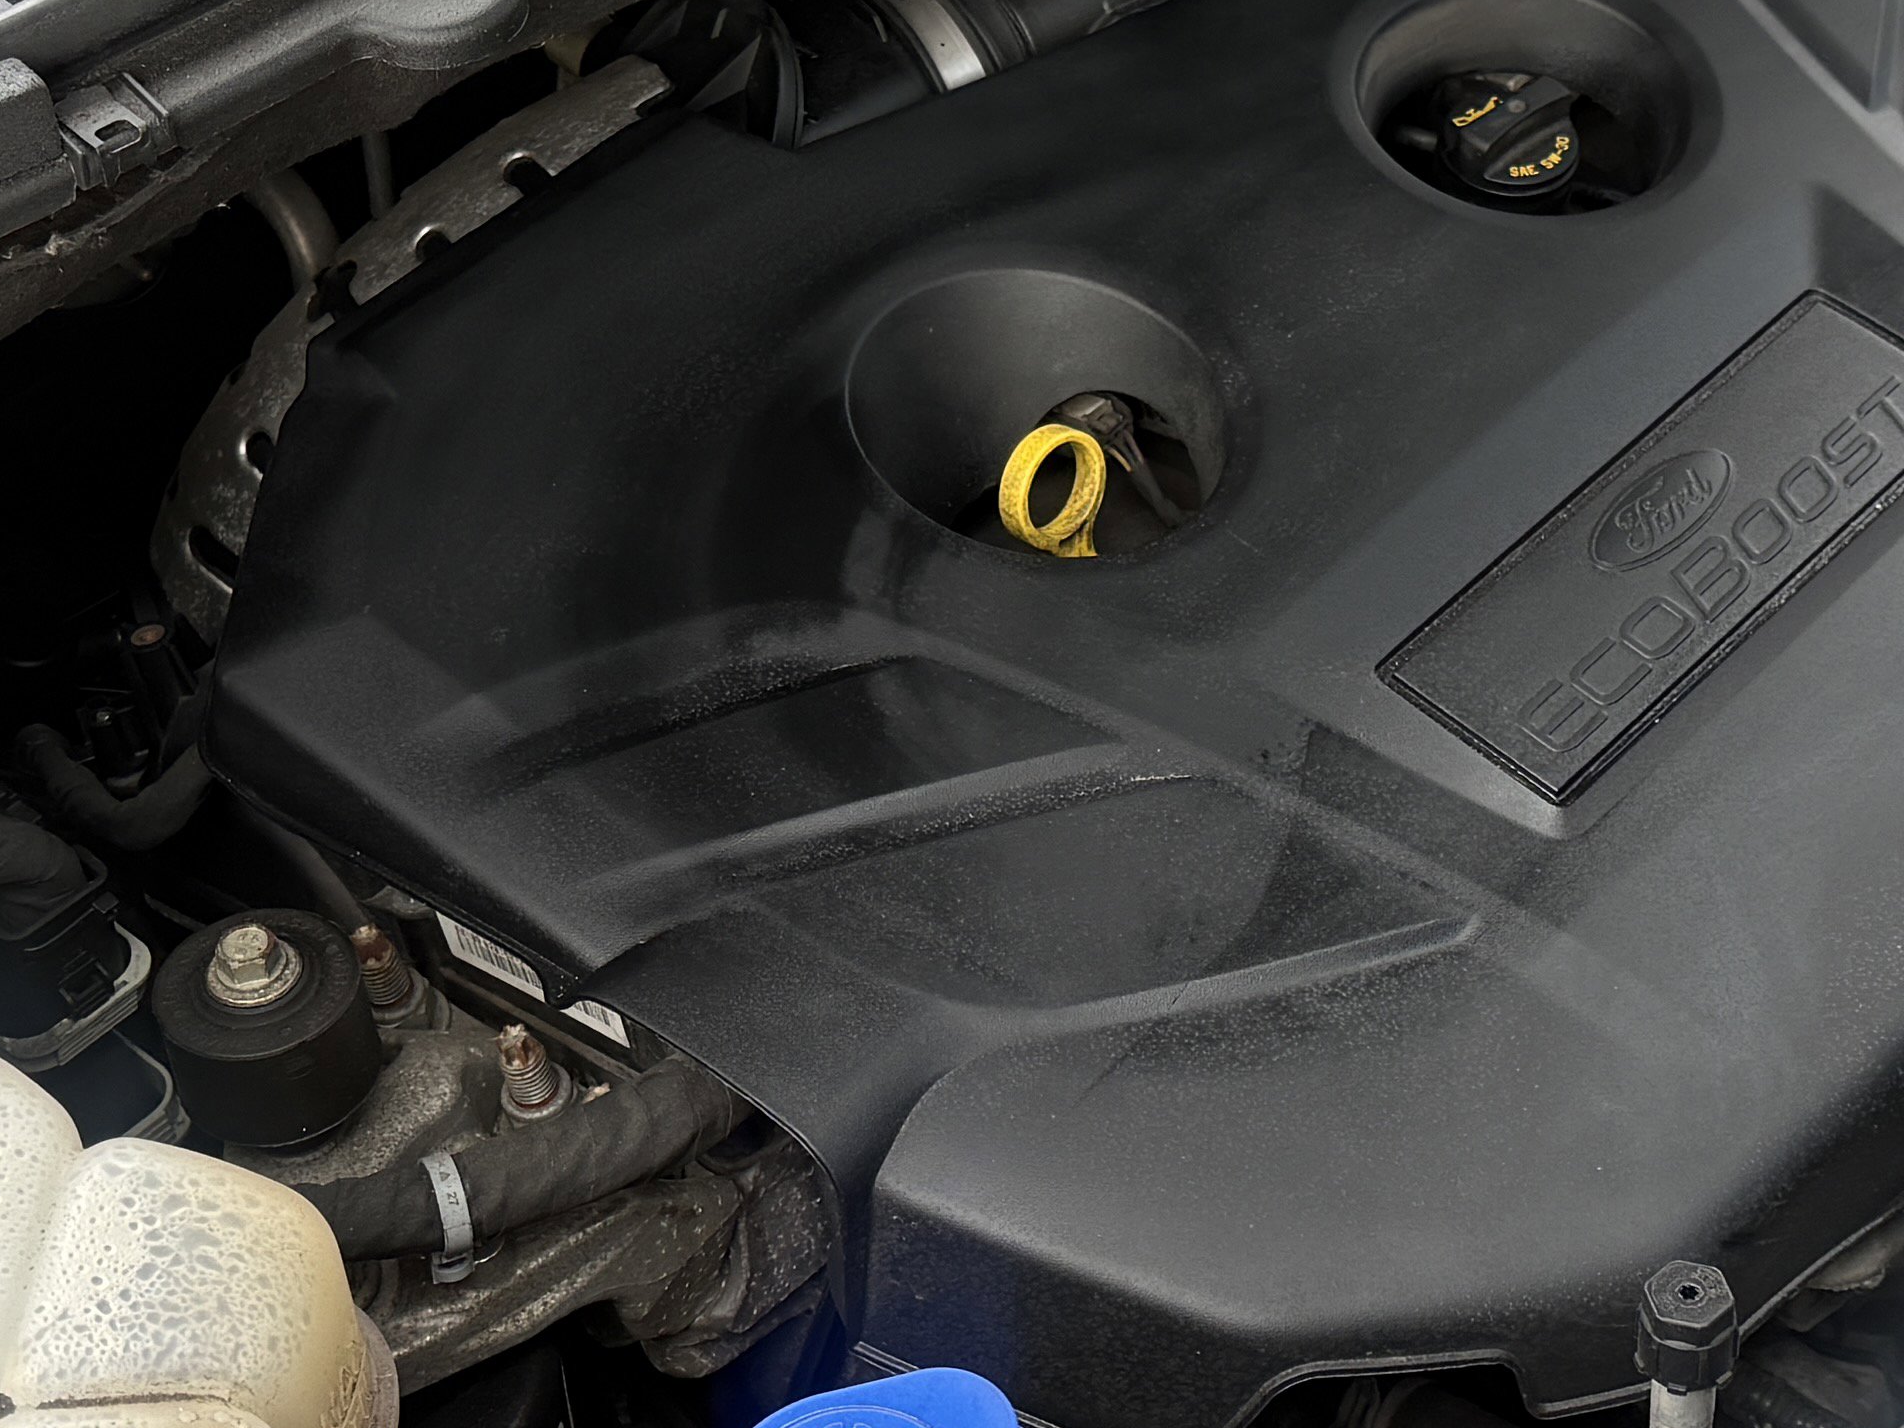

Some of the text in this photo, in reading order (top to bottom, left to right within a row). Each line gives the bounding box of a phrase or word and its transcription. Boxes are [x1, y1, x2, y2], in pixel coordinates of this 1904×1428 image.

[1509, 136, 1571, 178] SAE 5W-30
[1602, 459, 1721, 562] Ford
